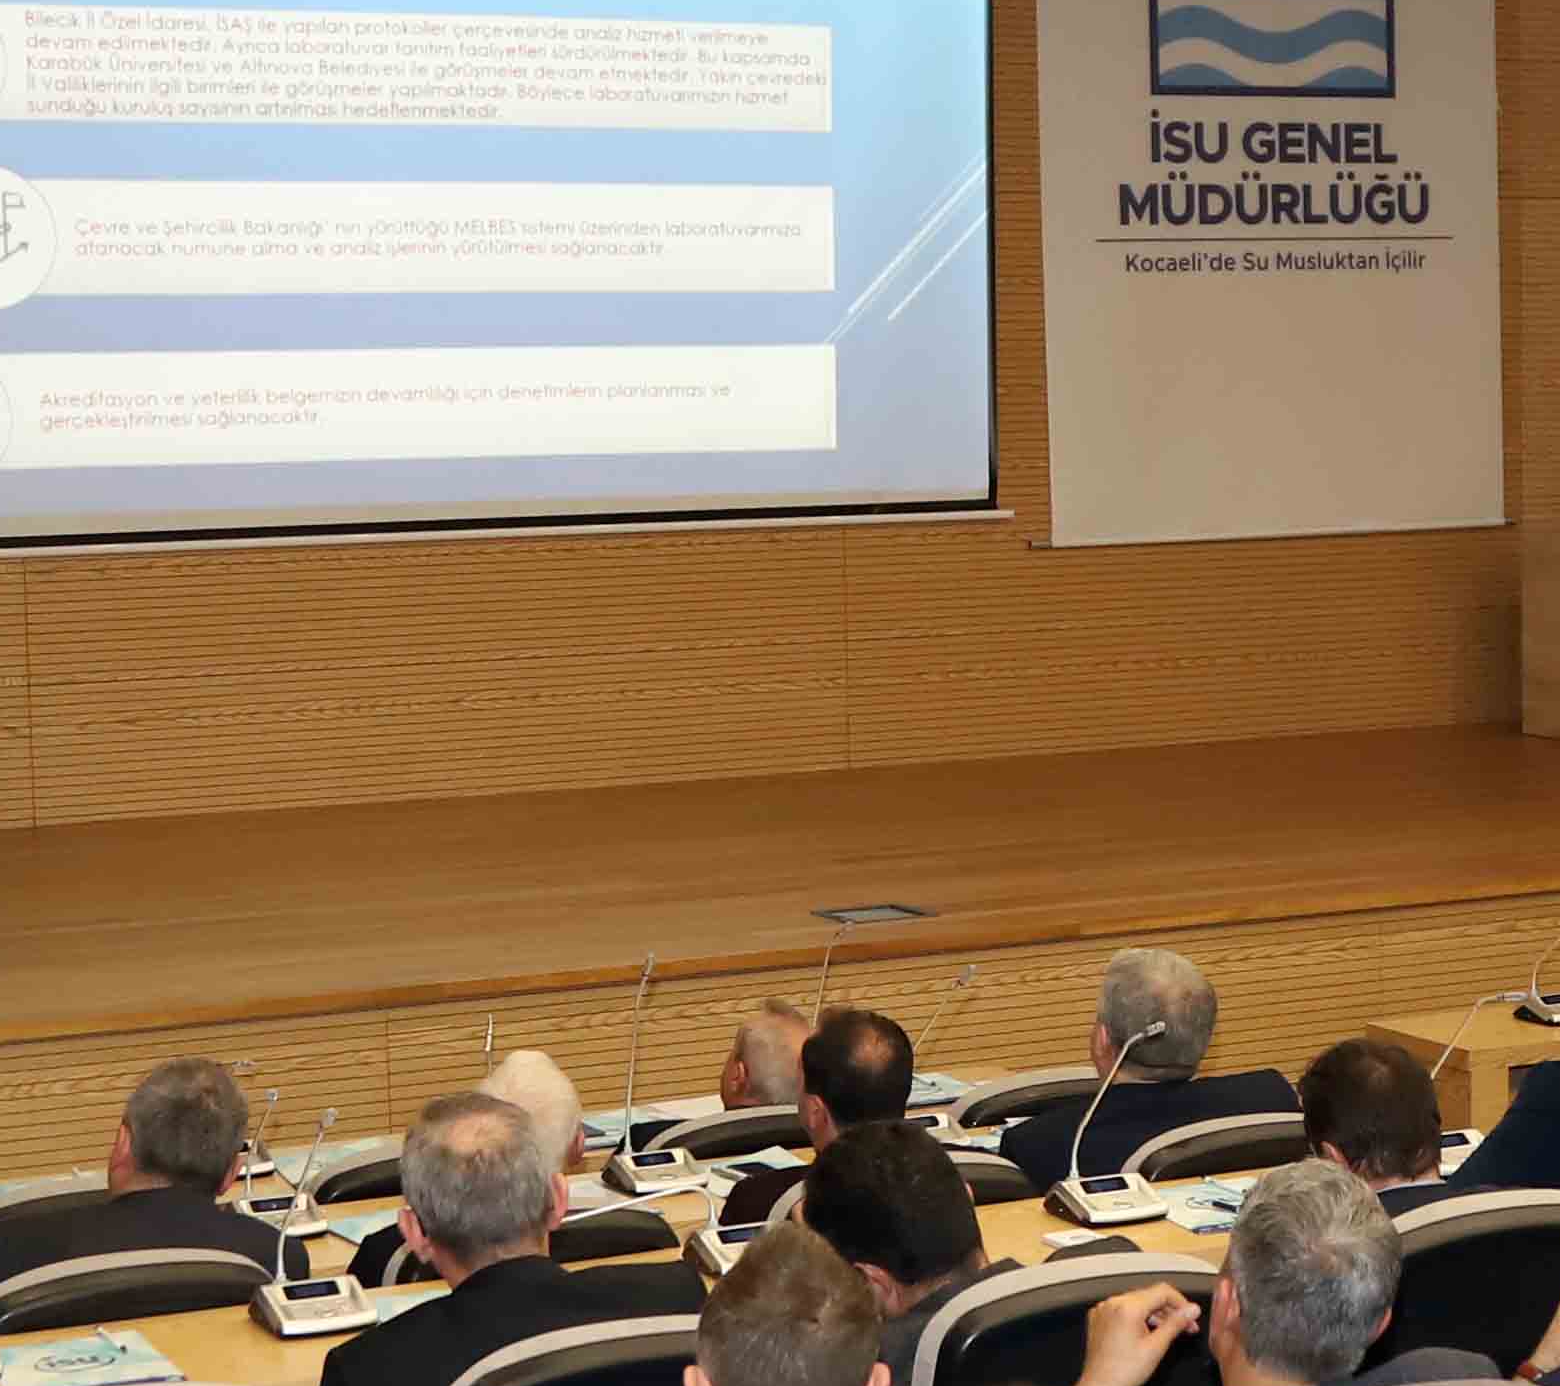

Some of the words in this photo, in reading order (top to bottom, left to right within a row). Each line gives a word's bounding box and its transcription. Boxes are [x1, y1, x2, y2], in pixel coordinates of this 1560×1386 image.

[1151, 108, 1227, 164] İSU
[1243, 121, 1398, 164] GENEL
[1119, 170, 1429, 226] MÜDÜRLÜĞÜ
[1125, 250, 1236, 273] Kocaeli'de
[1243, 250, 1269, 271] Su
[1276, 248, 1379, 271] Musluktan
[1384, 245, 1426, 273] İçilir
